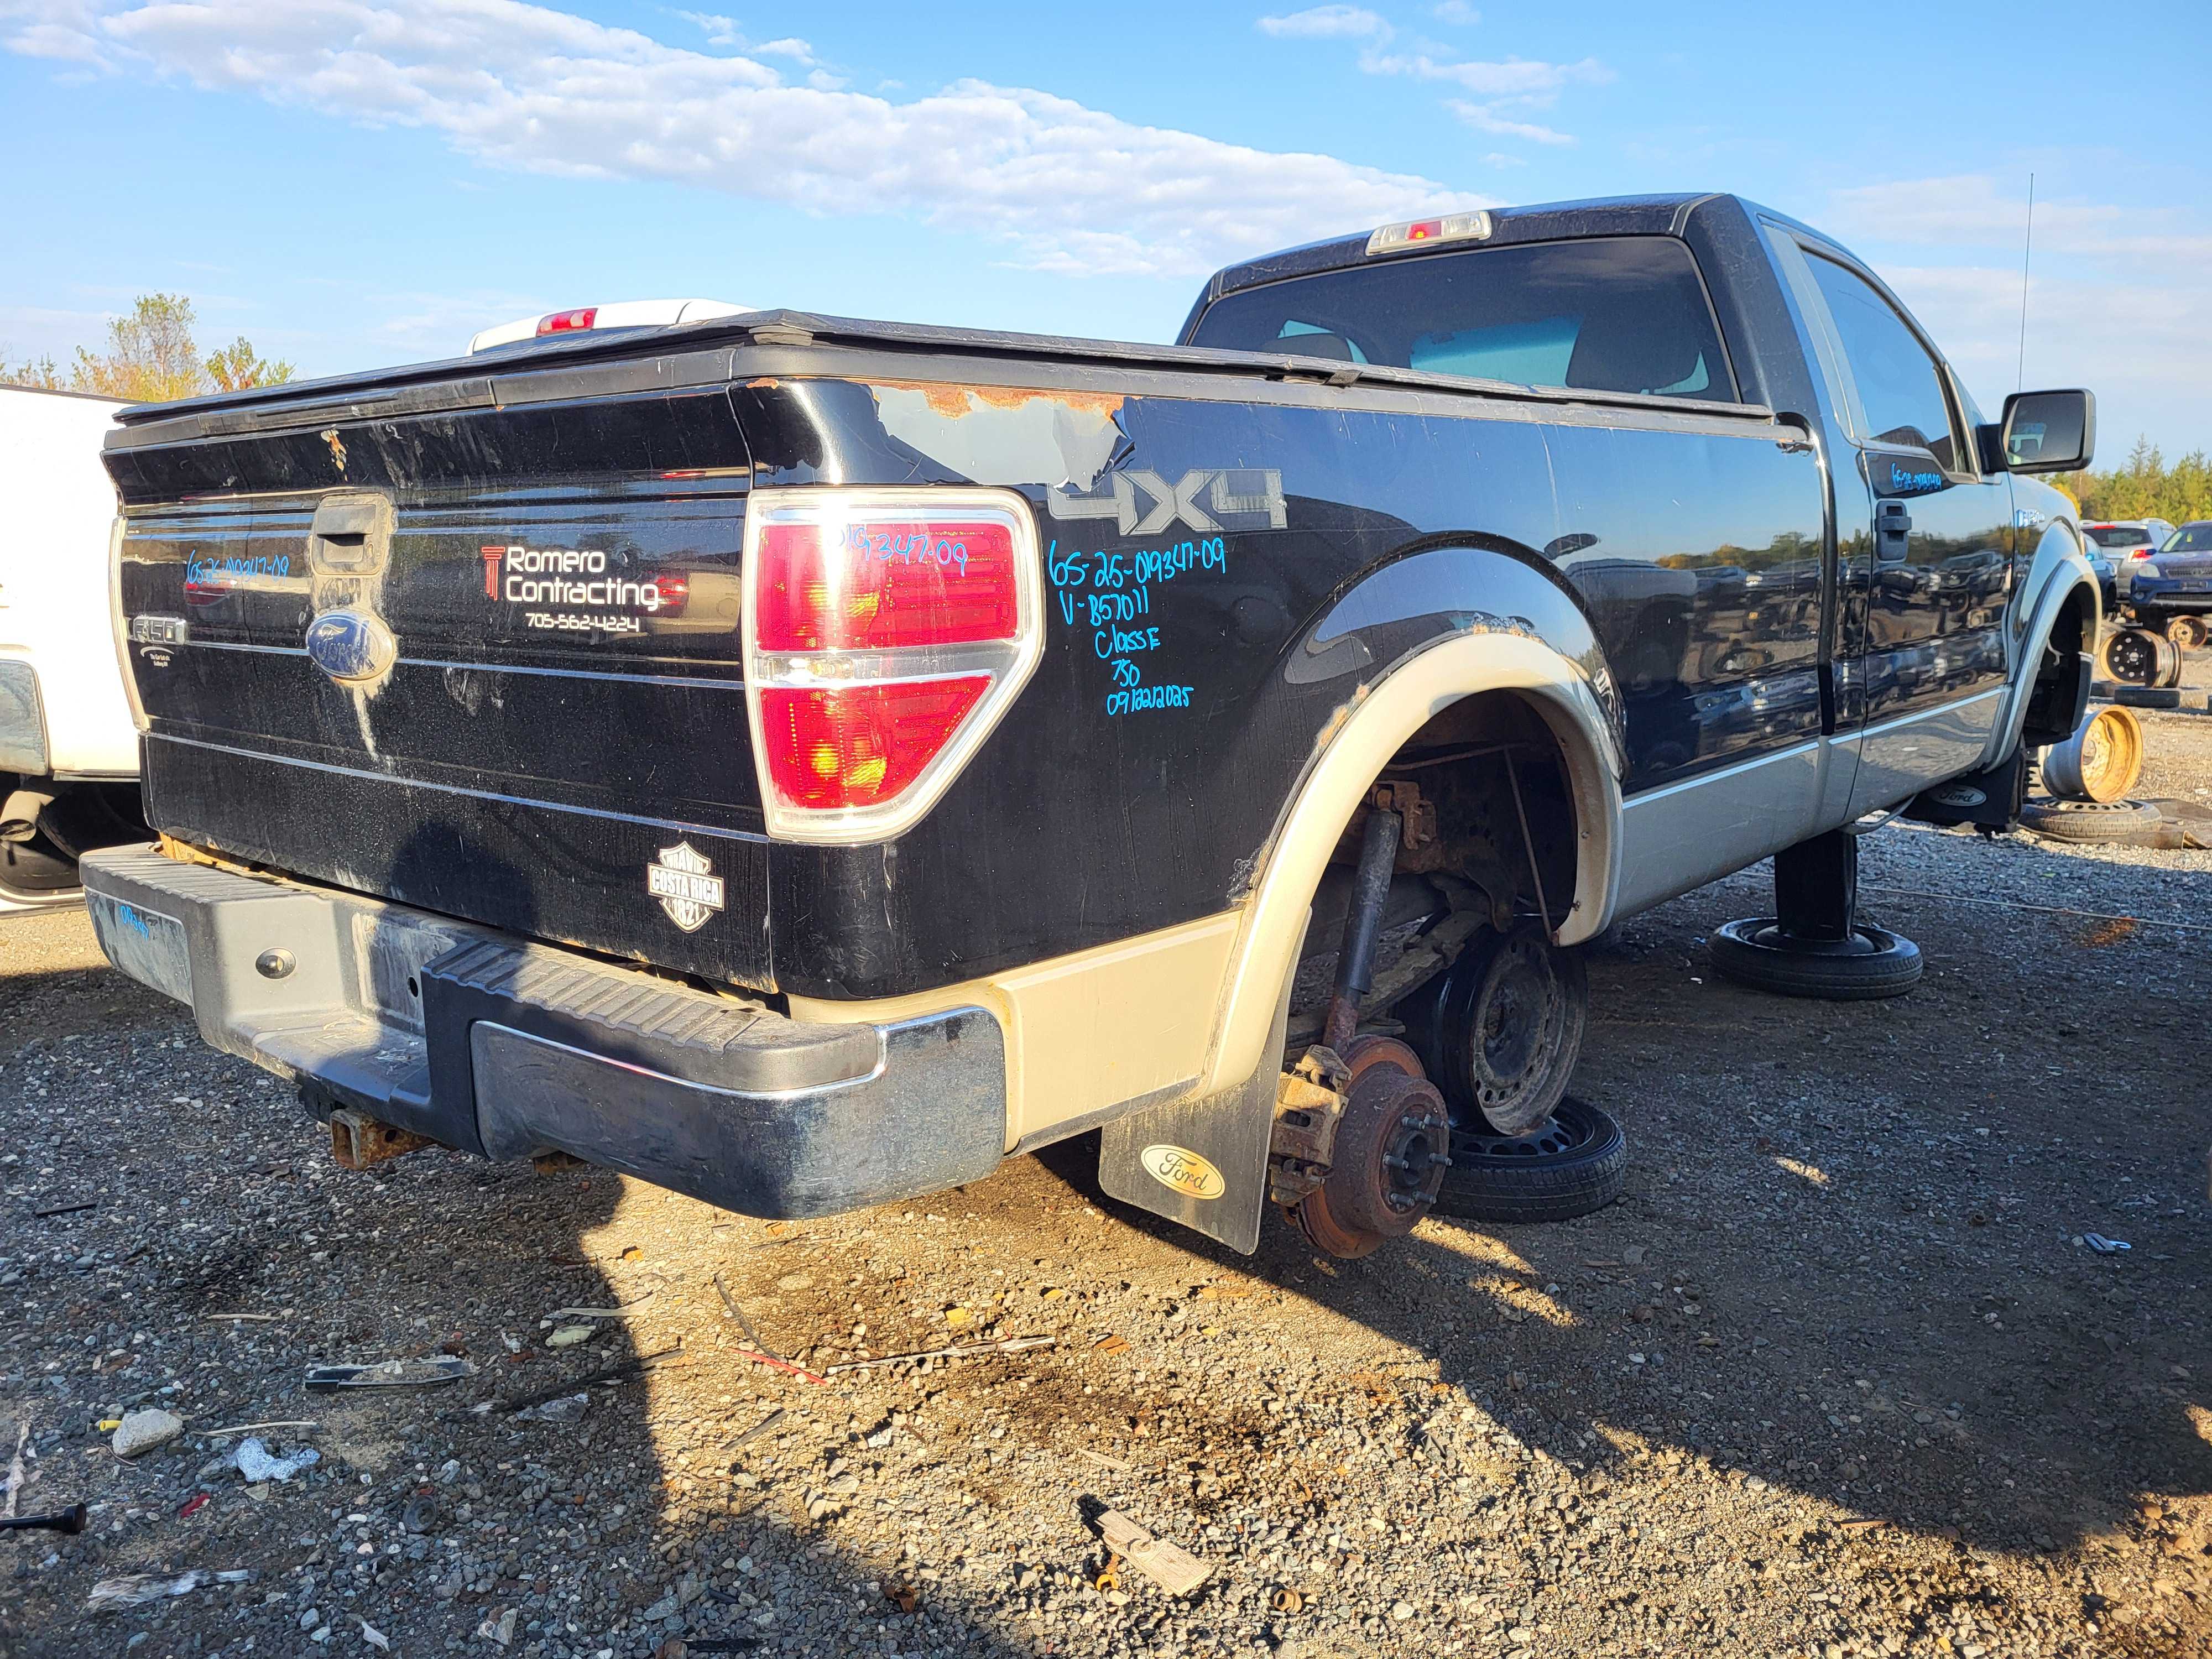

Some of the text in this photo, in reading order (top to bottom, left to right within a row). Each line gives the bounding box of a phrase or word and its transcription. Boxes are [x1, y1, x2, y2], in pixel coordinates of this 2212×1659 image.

[507, 546, 606, 573] Romero
[506, 576, 661, 611] Contracting
[525, 613, 640, 633] 705-562-4224
[1939, 788, 1975, 802] Ford
[651, 869, 720, 904] COSTA RICA
[672, 898, 700, 926] 1821
[1159, 1152, 1209, 1190] Ford
